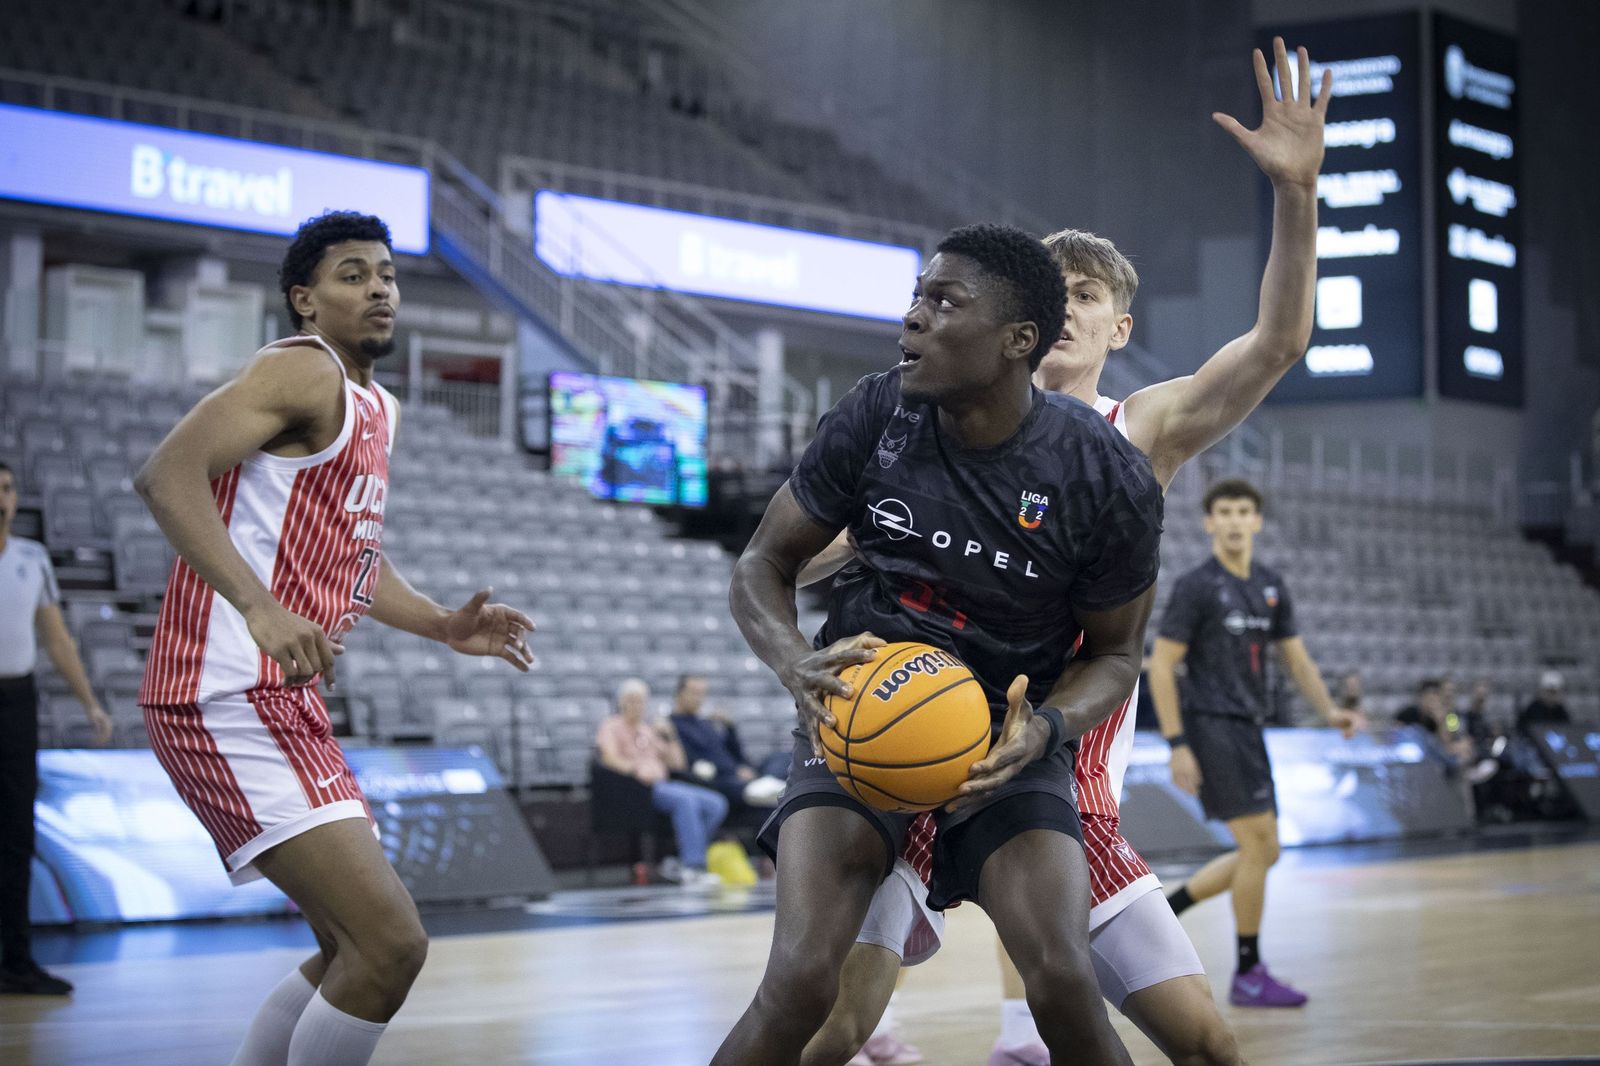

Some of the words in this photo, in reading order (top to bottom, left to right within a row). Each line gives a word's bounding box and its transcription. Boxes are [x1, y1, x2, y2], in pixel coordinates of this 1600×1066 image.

[131, 143, 165, 199] B
[167, 155, 293, 217] travel
[893, 404, 920, 423] ive
[1021, 490, 1049, 506] LIGA
[932, 530, 1039, 578] OPEL
[872, 648, 964, 702] Wilson
